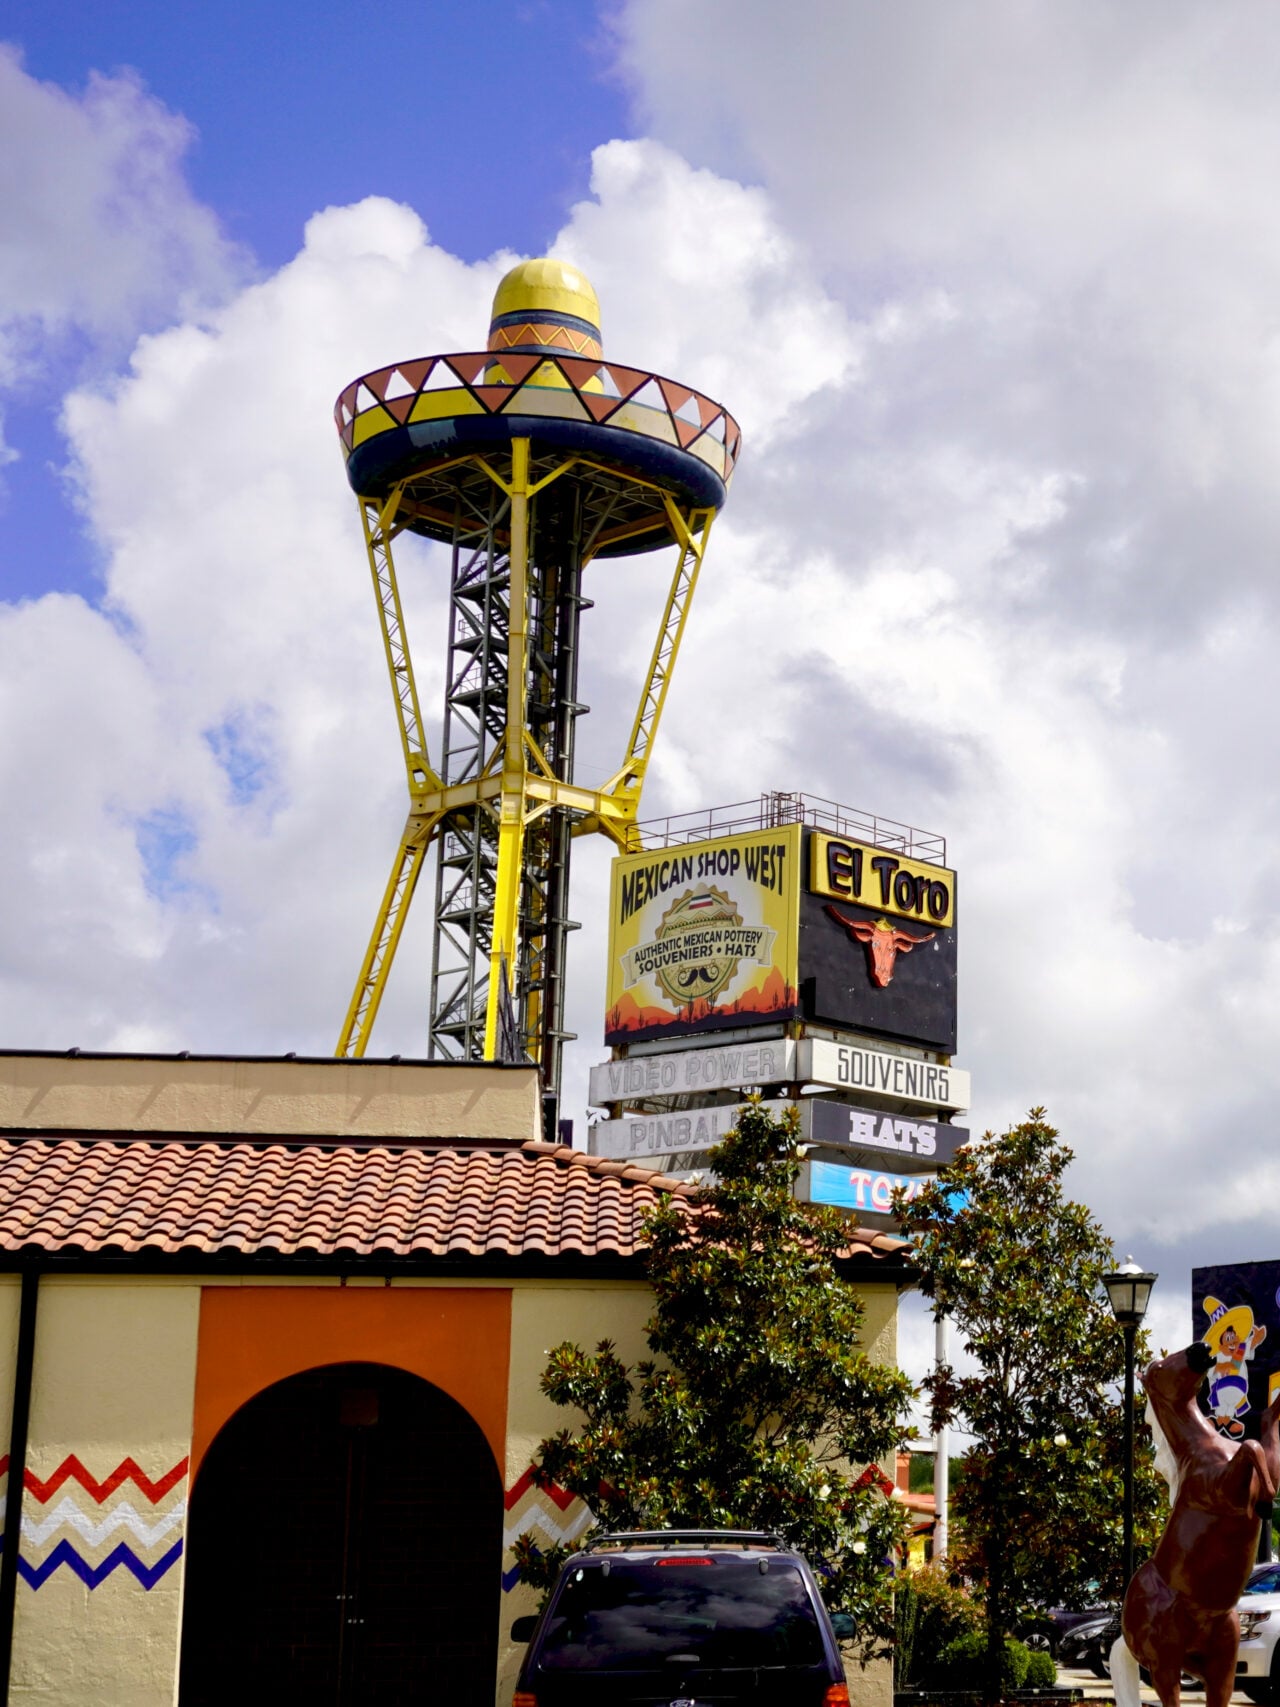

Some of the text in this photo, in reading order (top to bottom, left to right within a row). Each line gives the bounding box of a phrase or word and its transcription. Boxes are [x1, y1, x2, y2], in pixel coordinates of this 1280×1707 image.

[619, 843, 787, 926] MEXICAN SHOP WEST
[825, 841, 950, 922] El Toro
[633, 928, 763, 964] AUTHENTIC MEXICAN POTTERY
[638, 943, 757, 974] SOUVENIERS HATS
[608, 1048, 775, 1095] VIDEO POWER
[838, 1048, 950, 1103] SOUVENIRS
[849, 1111, 937, 1156] HATS
